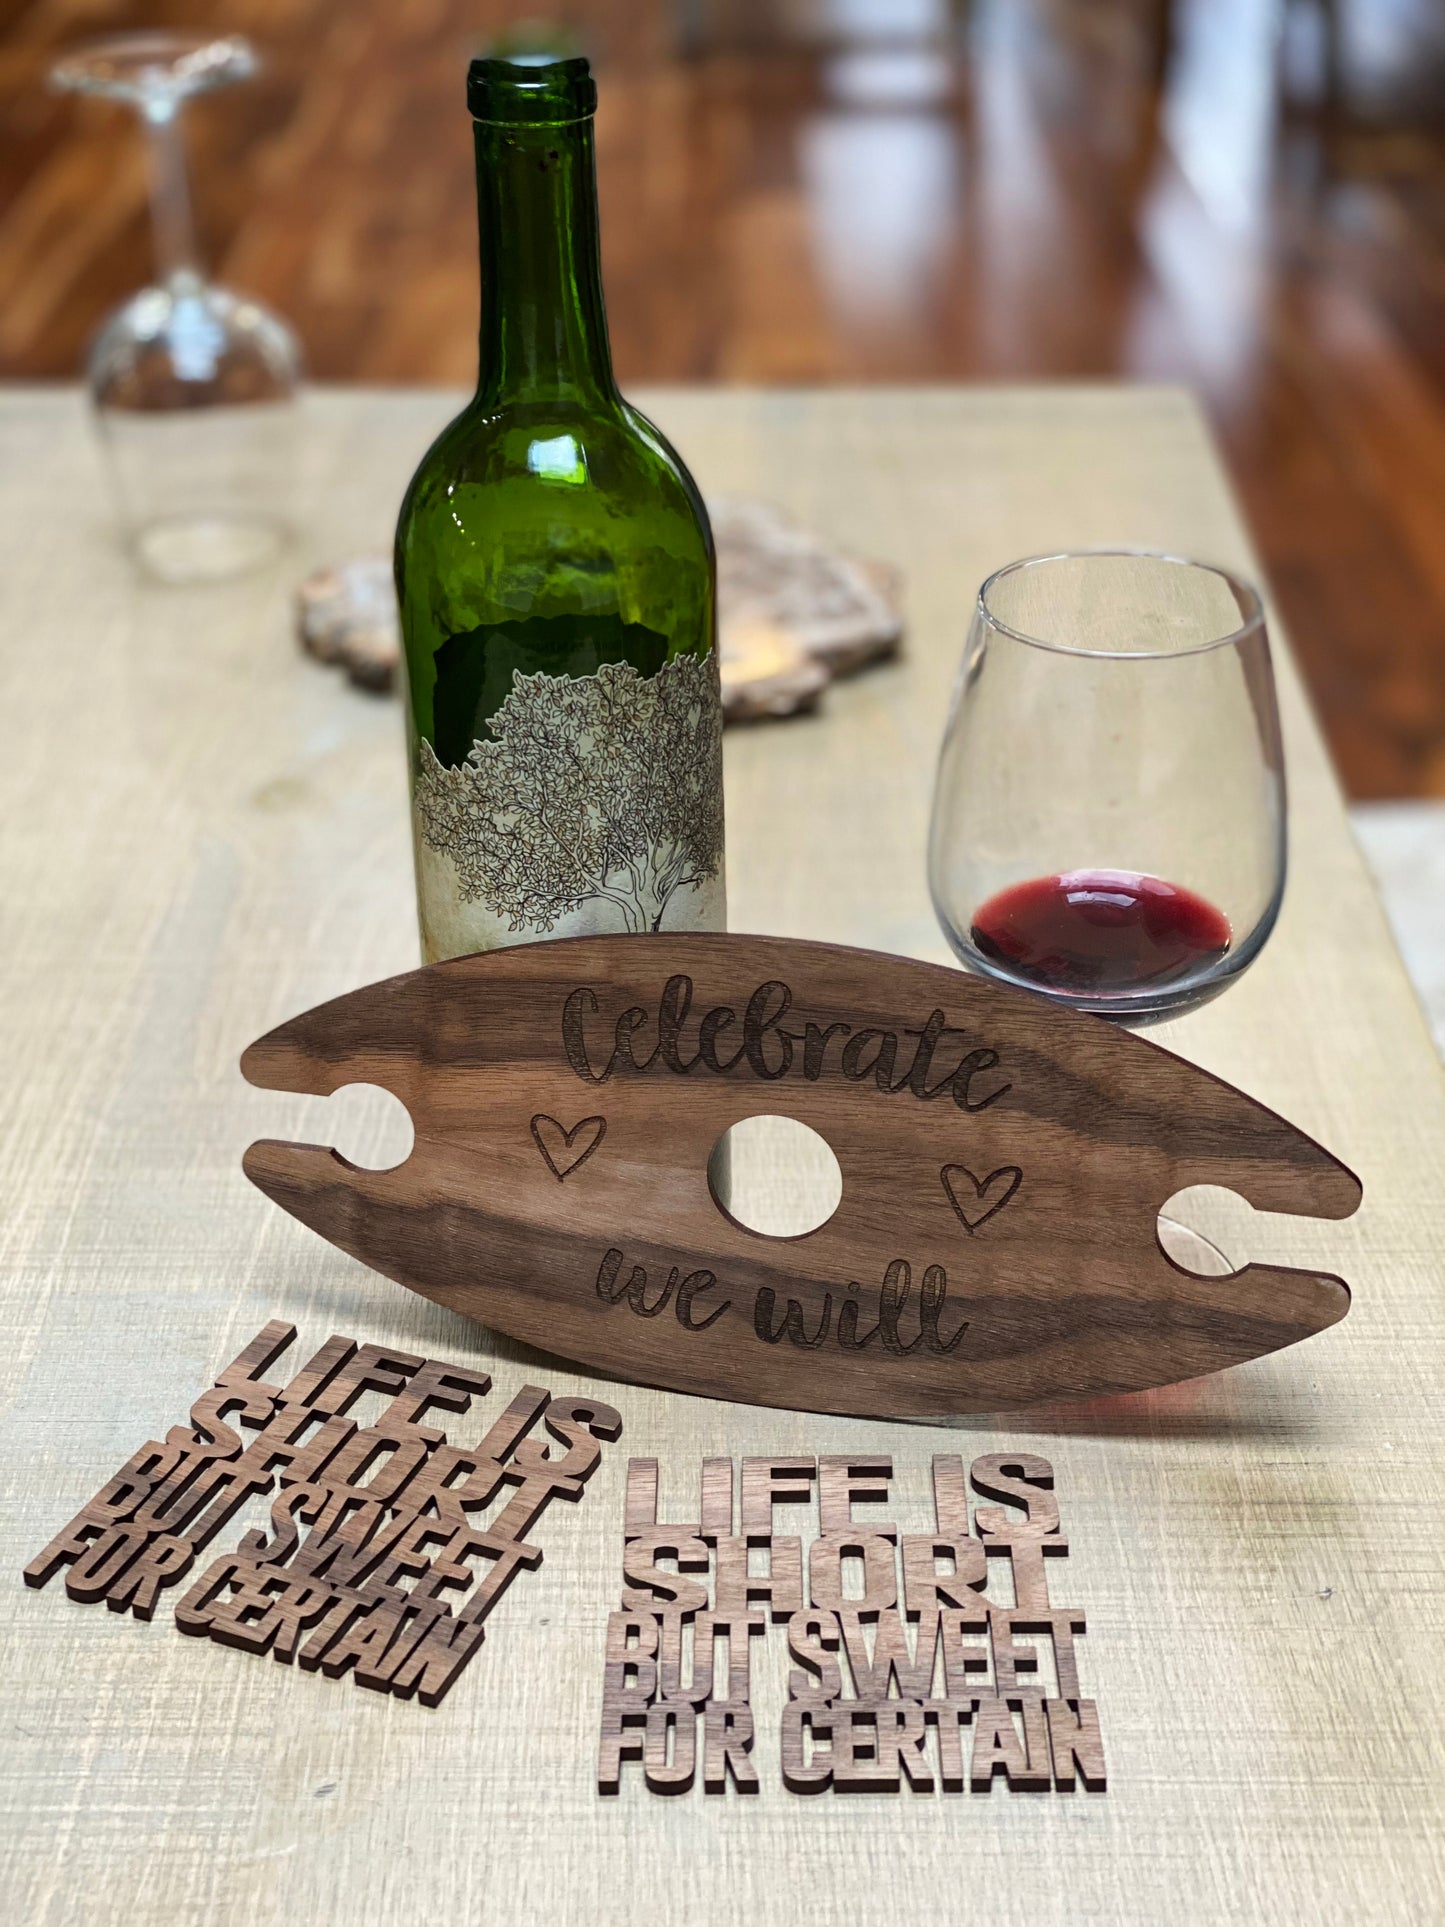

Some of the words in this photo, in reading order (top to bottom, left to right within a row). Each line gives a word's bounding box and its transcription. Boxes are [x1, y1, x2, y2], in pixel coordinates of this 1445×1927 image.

[561, 974, 1013, 1113] Celebrate
[595, 1247, 731, 1332] we
[753, 1258, 970, 1356] will
[215, 1319, 492, 1442] LIFE
[475, 1384, 623, 1482] IS
[166, 1386, 585, 1545] SHORT
[625, 1455, 896, 1540] LIFE
[931, 1453, 1060, 1537] IS
[83, 1439, 275, 1555] BUT
[237, 1481, 543, 1626] SWEET
[622, 1533, 1069, 1616] SHORT
[23, 1522, 195, 1622] FOR
[174, 1552, 486, 1709] CERTAIN
[604, 1610, 766, 1701] BUT
[788, 1608, 1087, 1700] SWEET
[598, 1699, 760, 1796] FOR
[782, 1698, 1107, 1794] CERTAIN
